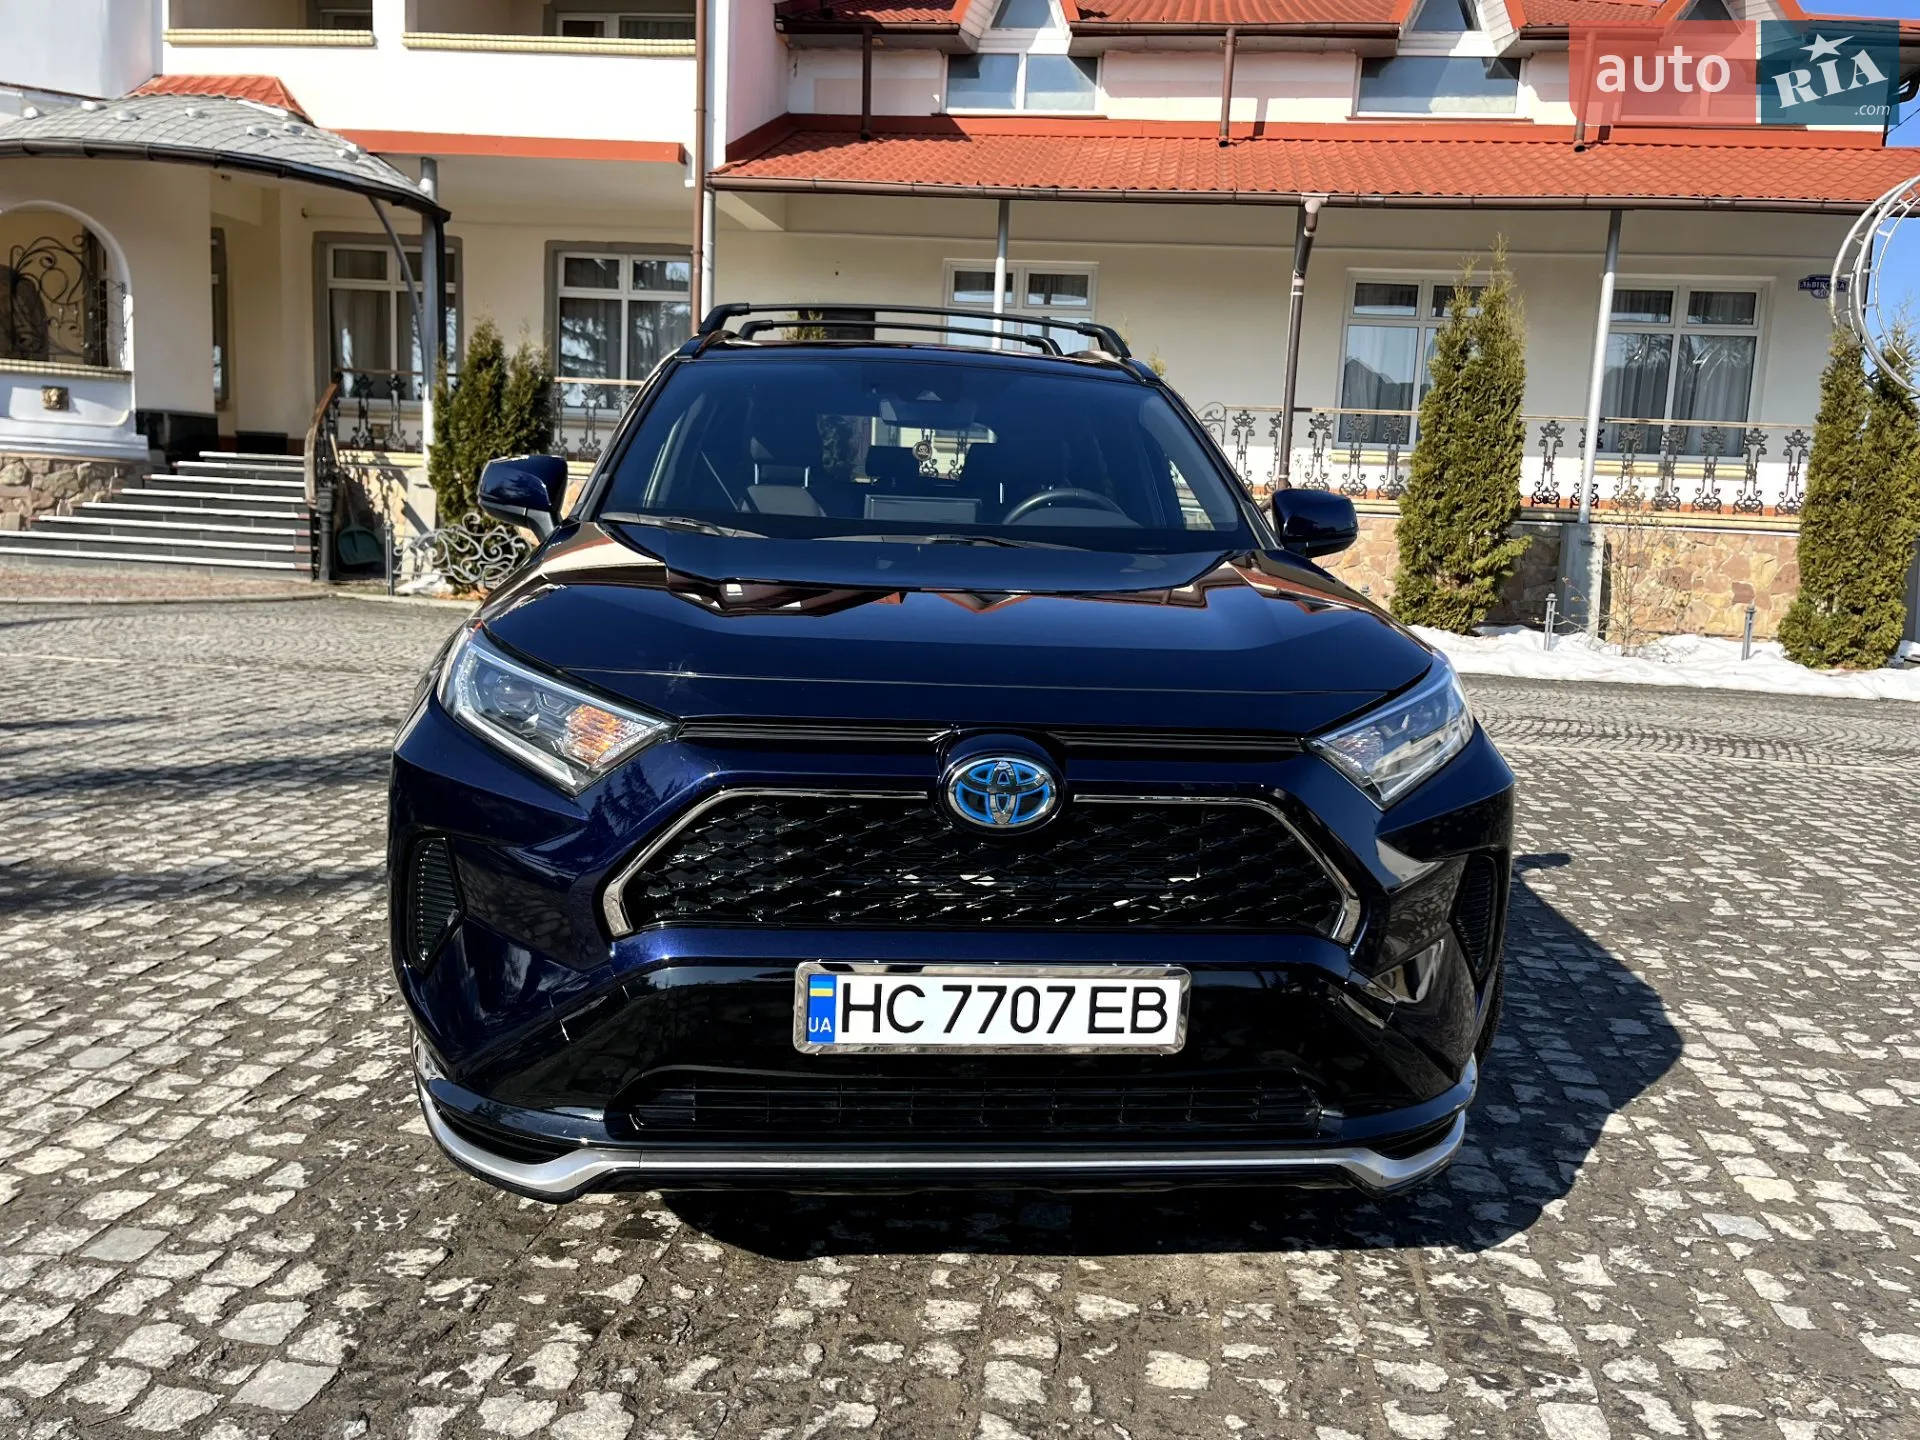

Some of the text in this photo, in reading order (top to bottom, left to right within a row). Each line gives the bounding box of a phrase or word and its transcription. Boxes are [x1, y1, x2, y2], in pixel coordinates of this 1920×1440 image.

[808, 1017, 832, 1033] UA
[841, 983, 1169, 1034] HC 7707 EB
